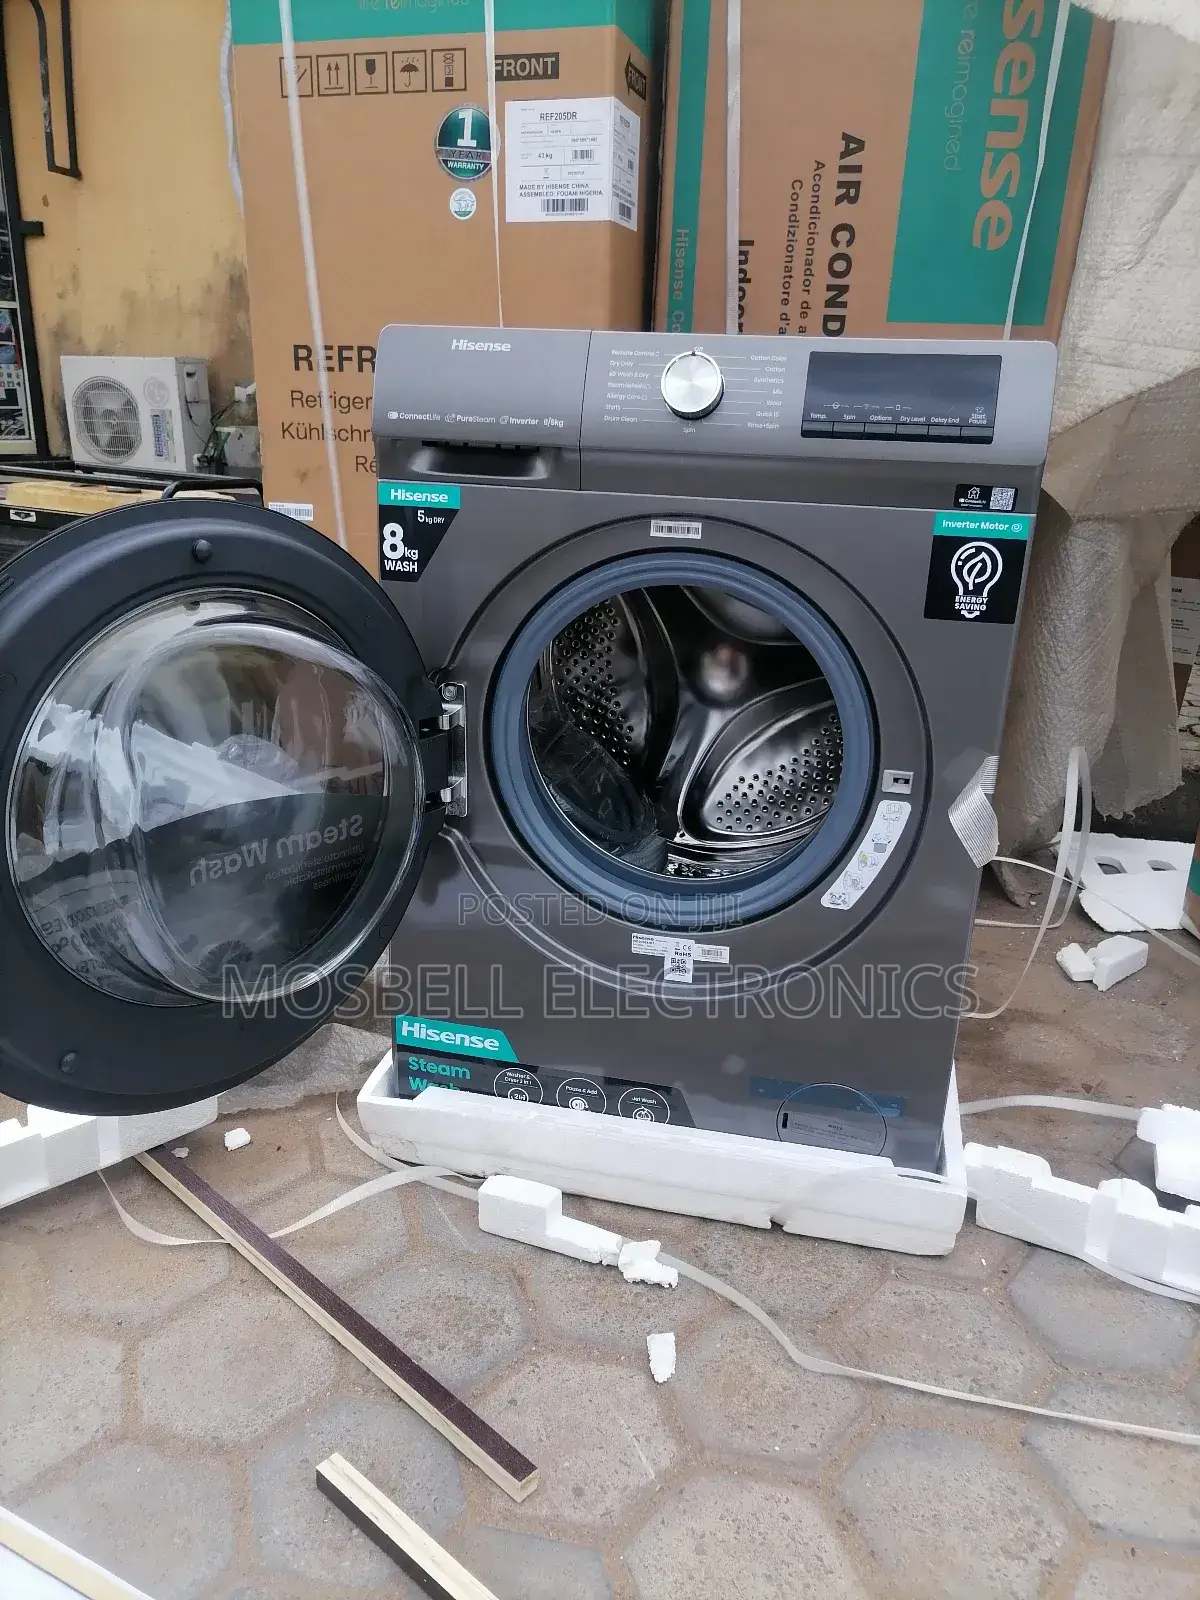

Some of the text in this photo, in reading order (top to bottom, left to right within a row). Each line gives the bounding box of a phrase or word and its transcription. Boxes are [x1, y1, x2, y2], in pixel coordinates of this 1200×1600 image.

[943, 29, 976, 171] reimagined
[539, 111, 578, 121] REF205DR
[457, 109, 477, 147] 1
[450, 149, 483, 161] YEAR
[447, 160, 485, 171] WARRANTY
[801, 160, 826, 296] Acondicionador
[821, 131, 866, 338] AIR COND
[780, 179, 804, 307] Condizionatore
[673, 228, 690, 300] Hisense
[799, 300, 812, 320] de
[451, 338, 512, 352] Hisense
[293, 344, 378, 373] REFR
[753, 376, 784, 384] Synthetics
[290, 390, 373, 414] Refiger
[399, 412, 441, 421] ConnectLife
[456, 414, 496, 424] PureSteam
[509, 416, 539, 425] Inverter
[843, 413, 856, 421] Spin
[869, 414, 893, 422] Options
[900, 415, 910, 423] Dry
[930, 416, 960, 424] Delay End
[281, 422, 372, 443] Kühlchr
[390, 488, 449, 503] Hisense
[433, 516, 445, 524] DRY
[942, 519, 1010, 531] Inverter Motor
[384, 559, 418, 573] WASH
[955, 595, 989, 604] ENERGY
[954, 602, 987, 611] SAVING
[401, 1020, 500, 1051] Hisense
[408, 1056, 471, 1080] Steam
[505, 1071, 526, 1079] Washer
[565, 1085, 582, 1093] Pause
[640, 1097, 657, 1105] Wash
